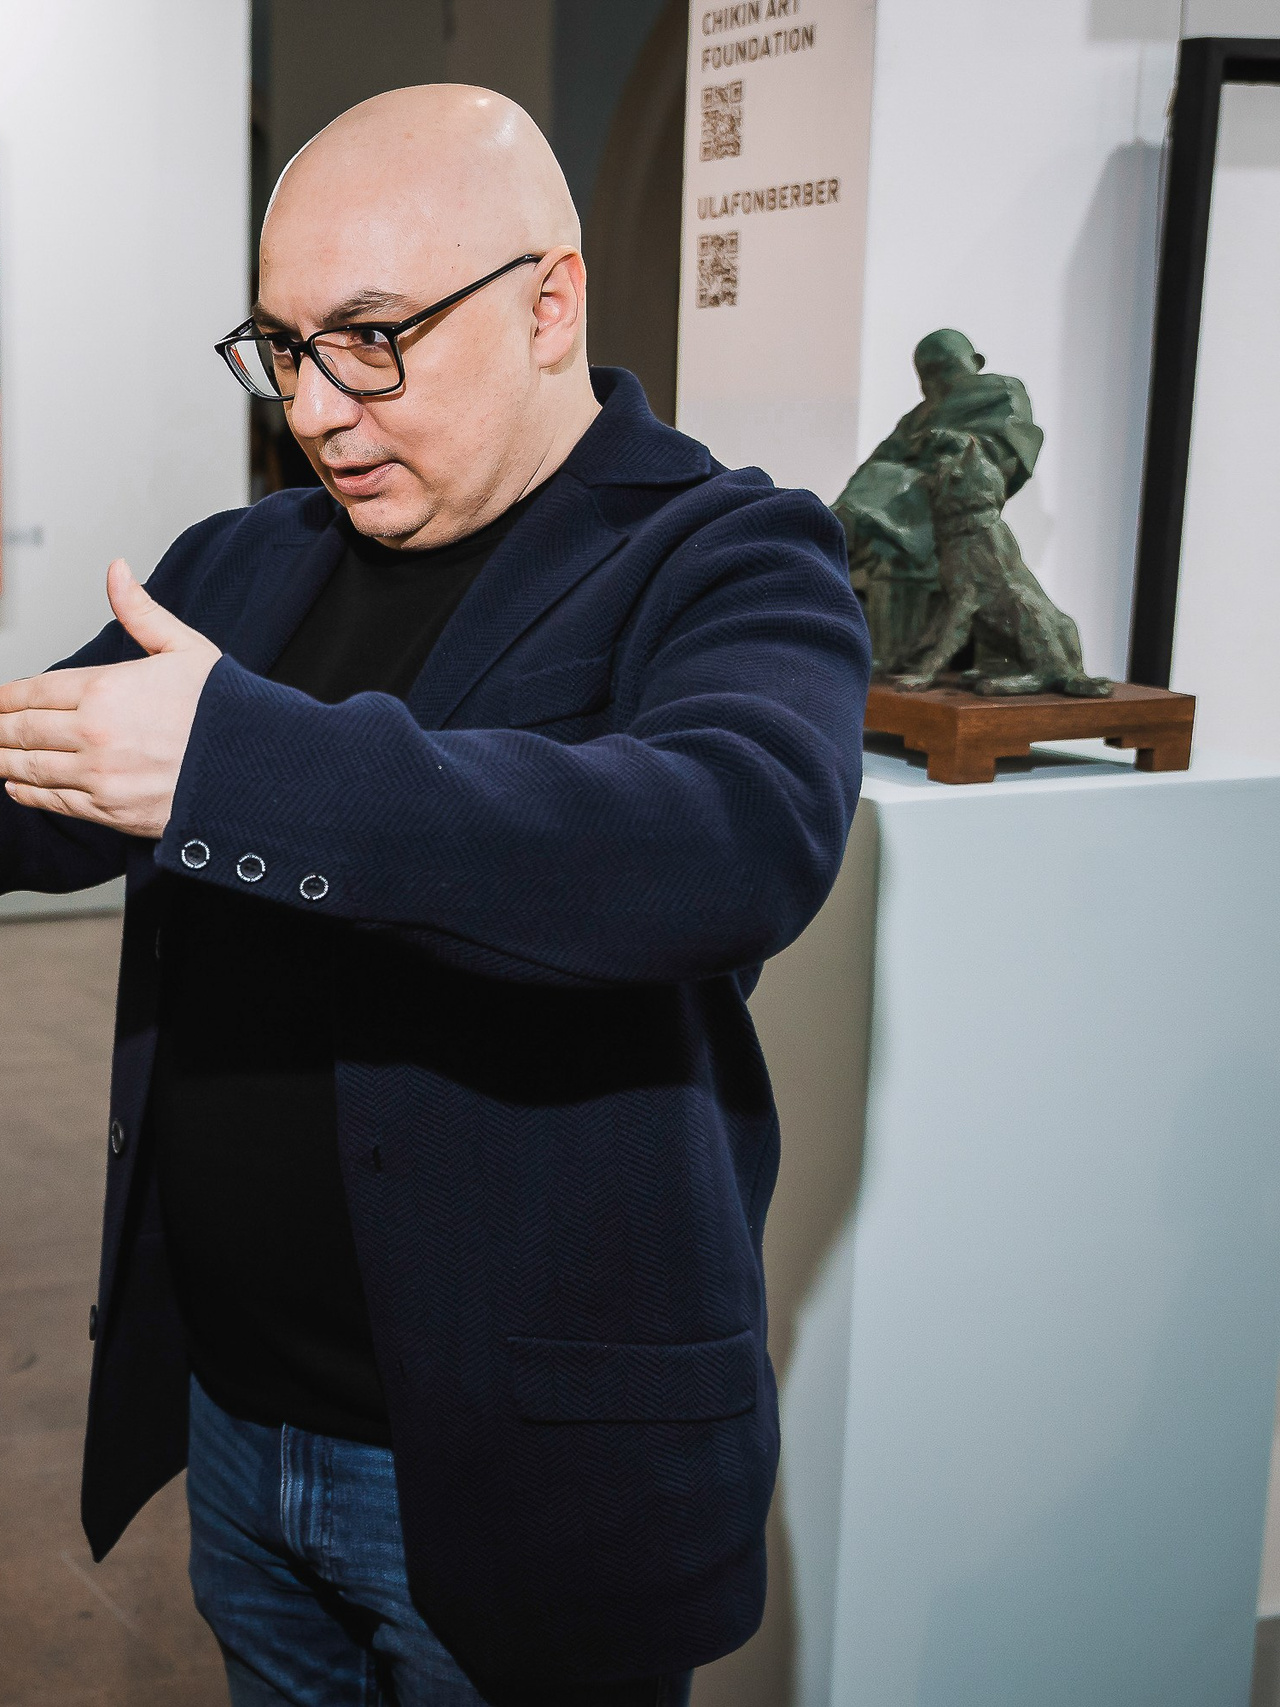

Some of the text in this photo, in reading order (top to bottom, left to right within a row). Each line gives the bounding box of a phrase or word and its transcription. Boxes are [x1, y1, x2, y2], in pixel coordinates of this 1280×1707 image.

[702, 0, 799, 36] CHIKIN ART
[701, 25, 816, 71] FOUNDATION
[697, 178, 839, 220] ULAFONBERBER
